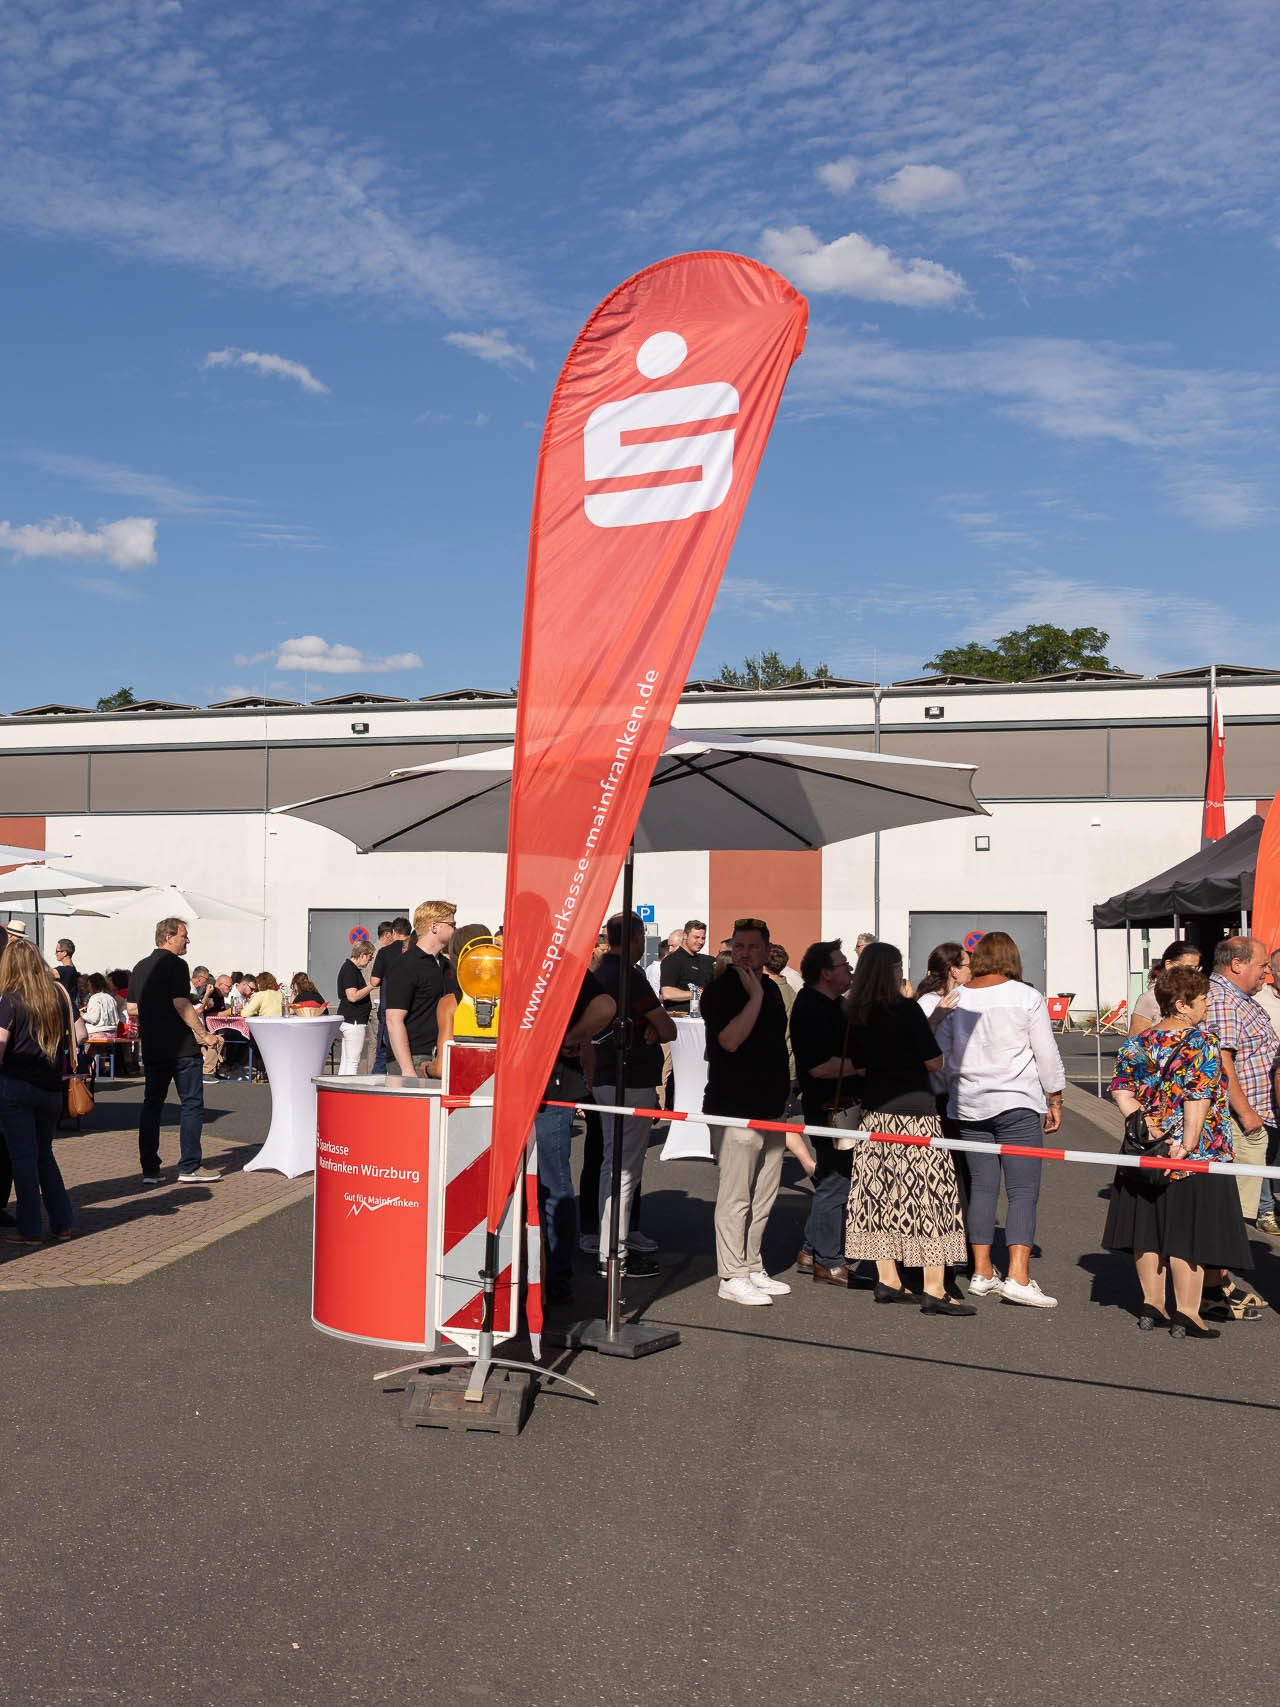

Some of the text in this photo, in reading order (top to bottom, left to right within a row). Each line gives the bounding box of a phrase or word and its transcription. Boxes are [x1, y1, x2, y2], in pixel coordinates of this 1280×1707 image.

[520, 670, 659, 1030] www.sparkasse-mainfranken.de
[640, 907, 651, 921] P
[360, 1164, 420, 1183] Würzburg
[344, 1192, 420, 1208] Gut für Mainfranken
